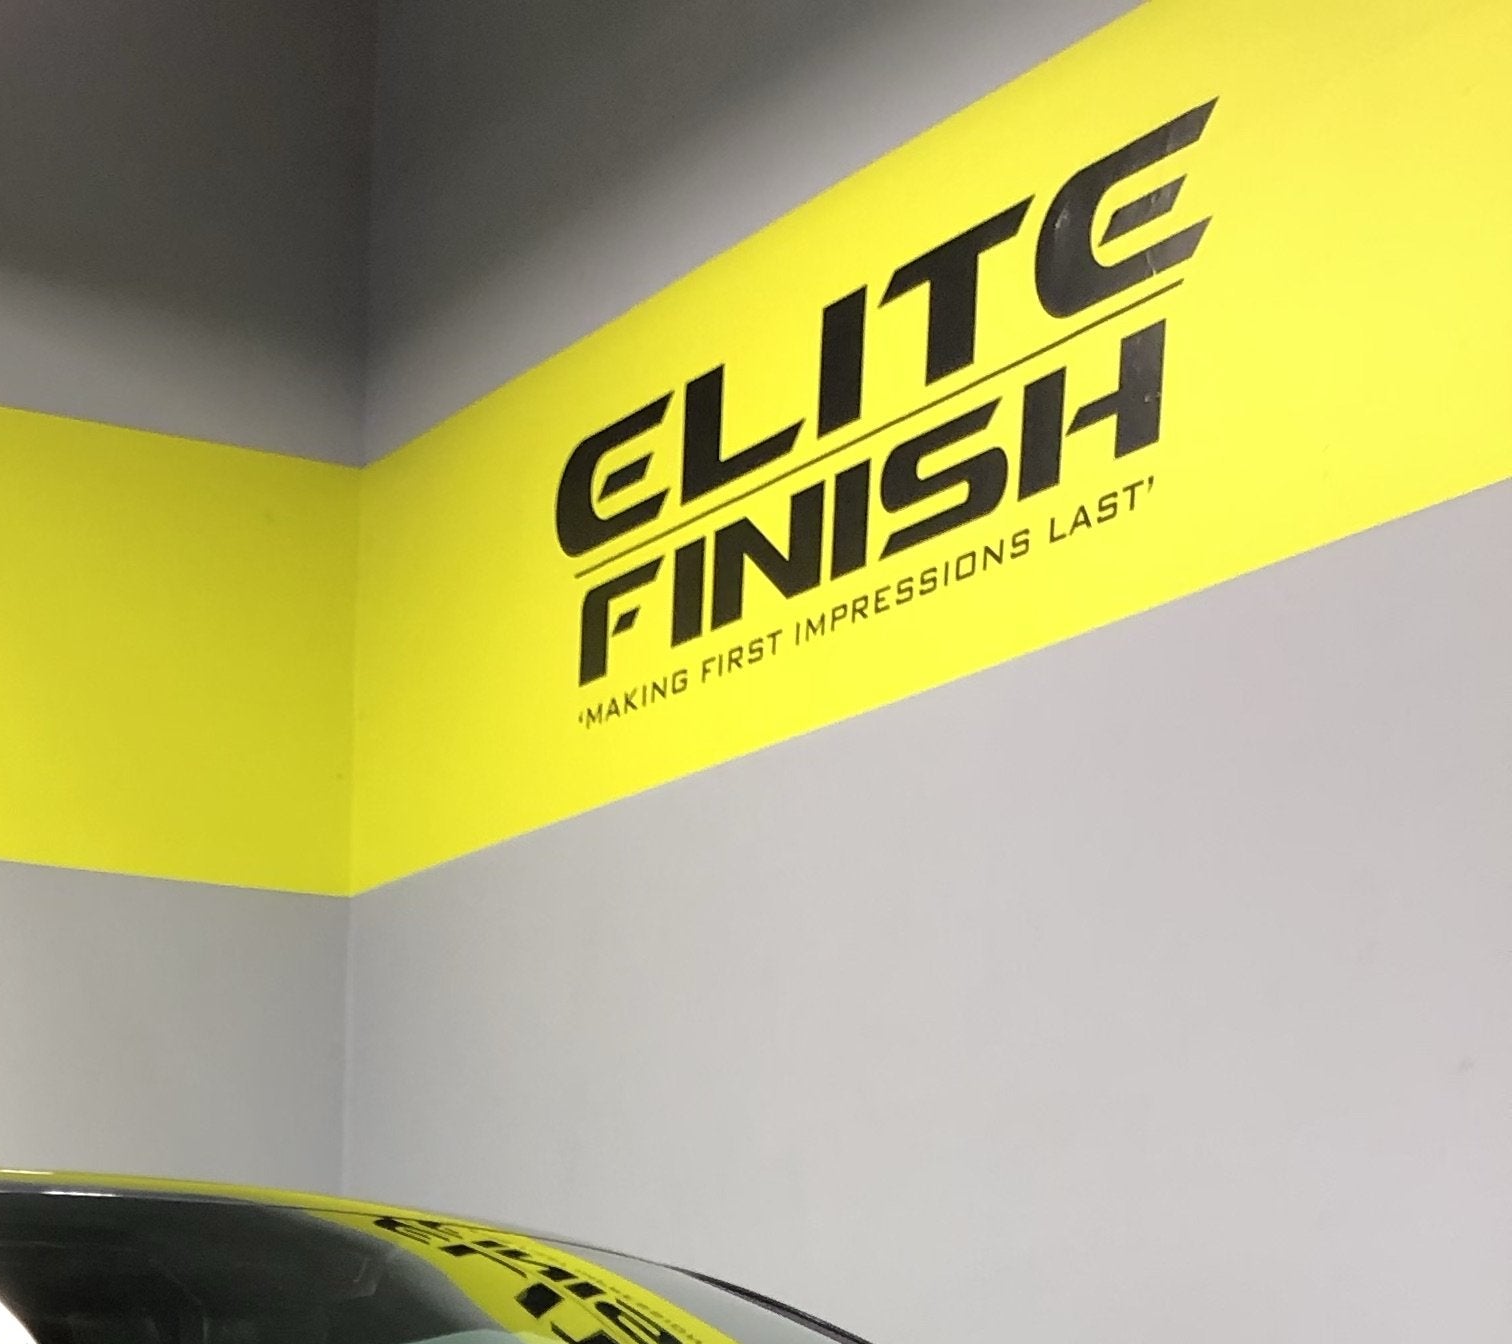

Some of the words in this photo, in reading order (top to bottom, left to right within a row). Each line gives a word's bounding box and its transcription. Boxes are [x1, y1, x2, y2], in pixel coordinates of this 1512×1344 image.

[555, 96, 1219, 557] ELITE
[579, 318, 1166, 687] FINISH
[701, 629, 783, 683] FIRST
[795, 528, 1030, 646] IMPRESSIONS
